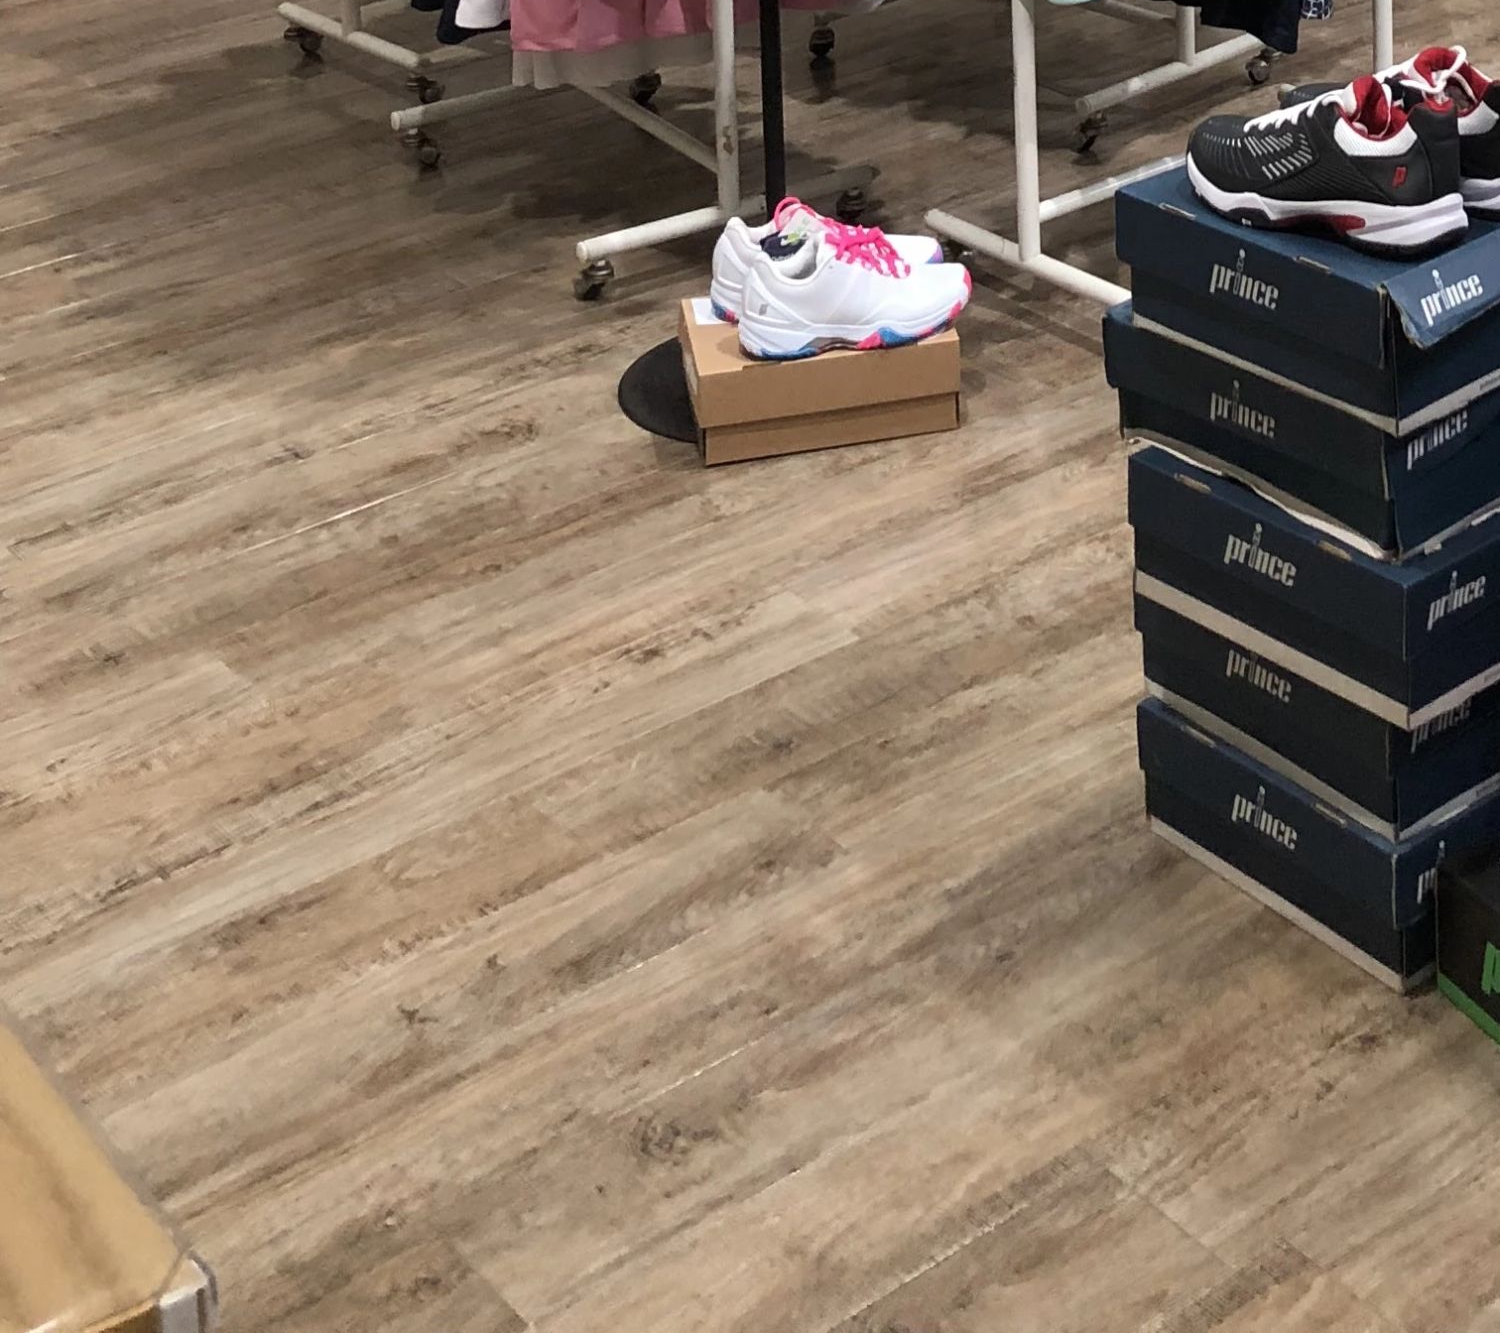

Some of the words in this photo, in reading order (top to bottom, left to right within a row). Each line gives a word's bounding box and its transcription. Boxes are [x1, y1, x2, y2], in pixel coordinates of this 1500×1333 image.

[1208, 248, 1280, 311] prince
[1420, 269, 1485, 326] prince
[1210, 379, 1276, 440] prince
[1223, 522, 1297, 587] prince
[1426, 569, 1487, 631] prince
[1225, 646, 1293, 704] prince
[1231, 785, 1298, 852] prince
